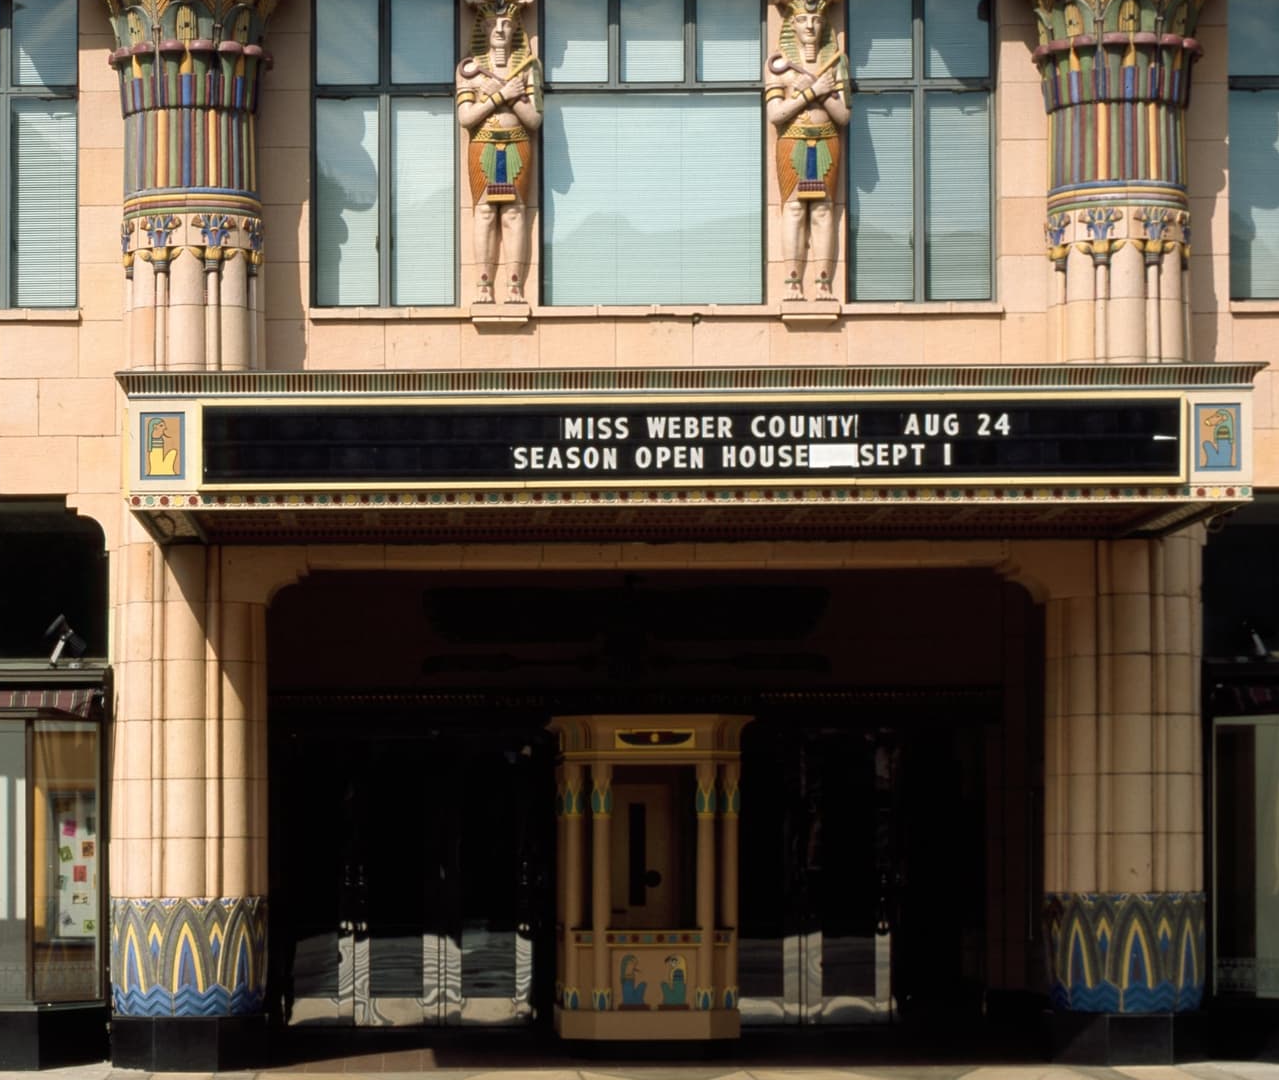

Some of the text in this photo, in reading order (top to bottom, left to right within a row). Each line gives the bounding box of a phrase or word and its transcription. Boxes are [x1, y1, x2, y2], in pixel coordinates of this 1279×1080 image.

[564, 413, 1011, 440] MISS WEBER COUNTY AUG 24
[513, 446, 618, 470] SEASON
[635, 446, 705, 469] OPEN
[722, 444, 808, 469] HOUSE
[860, 442, 926, 466] SEPT
